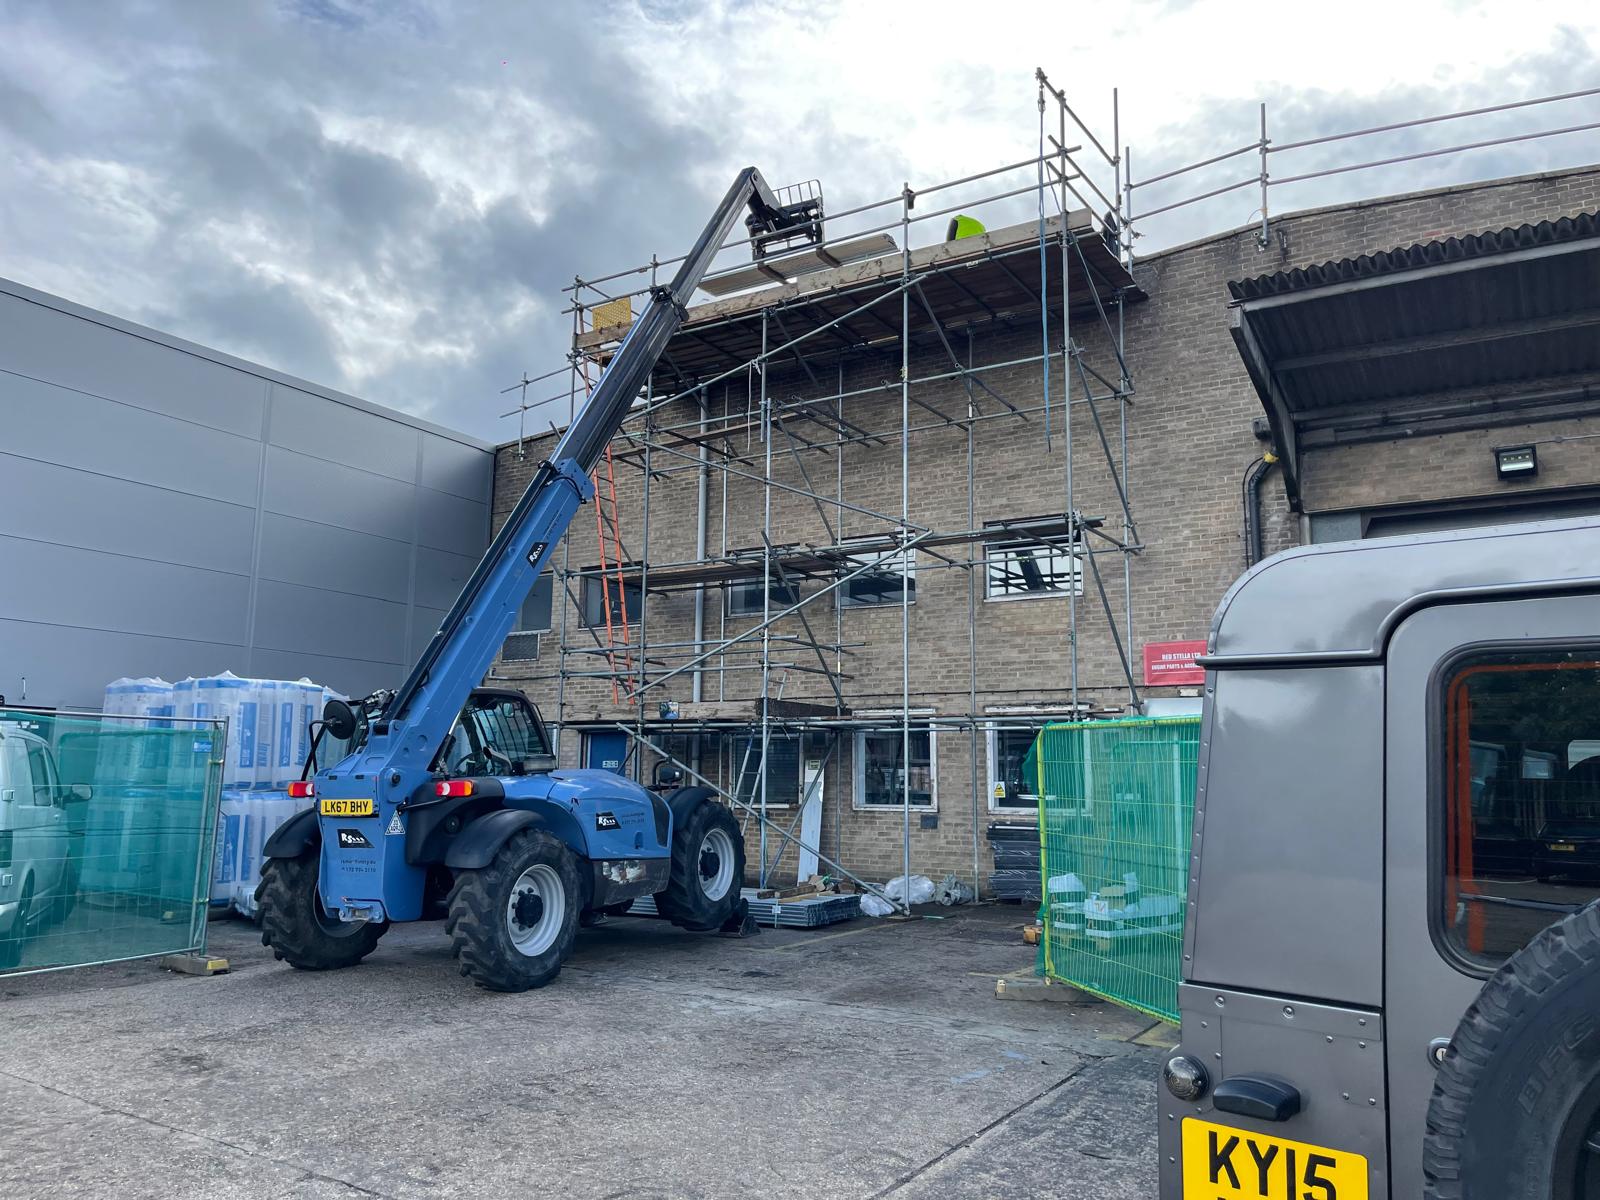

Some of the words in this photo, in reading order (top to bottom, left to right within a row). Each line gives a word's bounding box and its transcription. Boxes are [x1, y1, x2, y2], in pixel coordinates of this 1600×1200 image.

[325, 801, 347, 813] LK67
[350, 801, 369, 813] BHY
[1209, 1131, 1336, 1200] KY15
